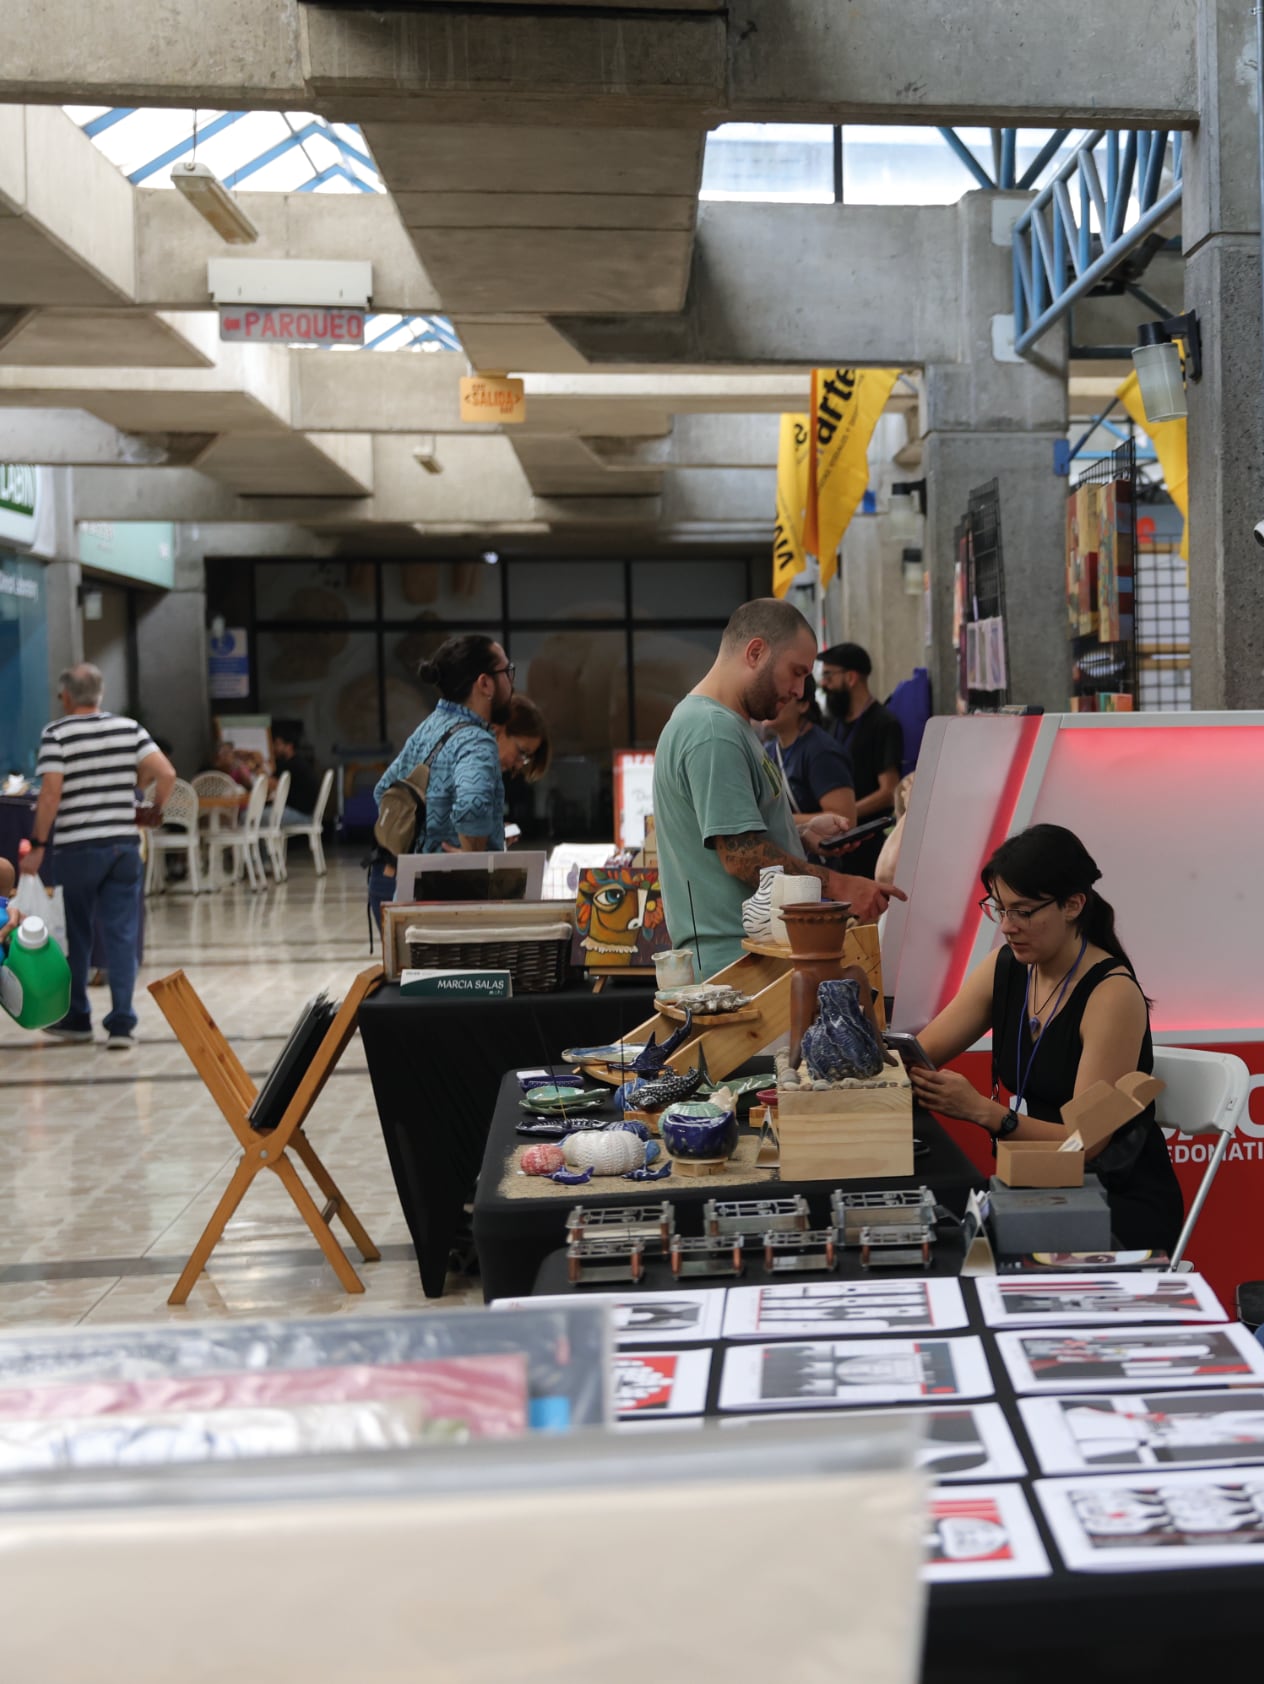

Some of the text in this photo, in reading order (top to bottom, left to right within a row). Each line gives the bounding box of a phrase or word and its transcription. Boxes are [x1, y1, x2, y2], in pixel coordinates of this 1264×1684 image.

[244, 311, 363, 339] PARQUEO
[472, 391, 513, 407] SALIDA
[437, 979, 504, 990] MARCIA SALAS
